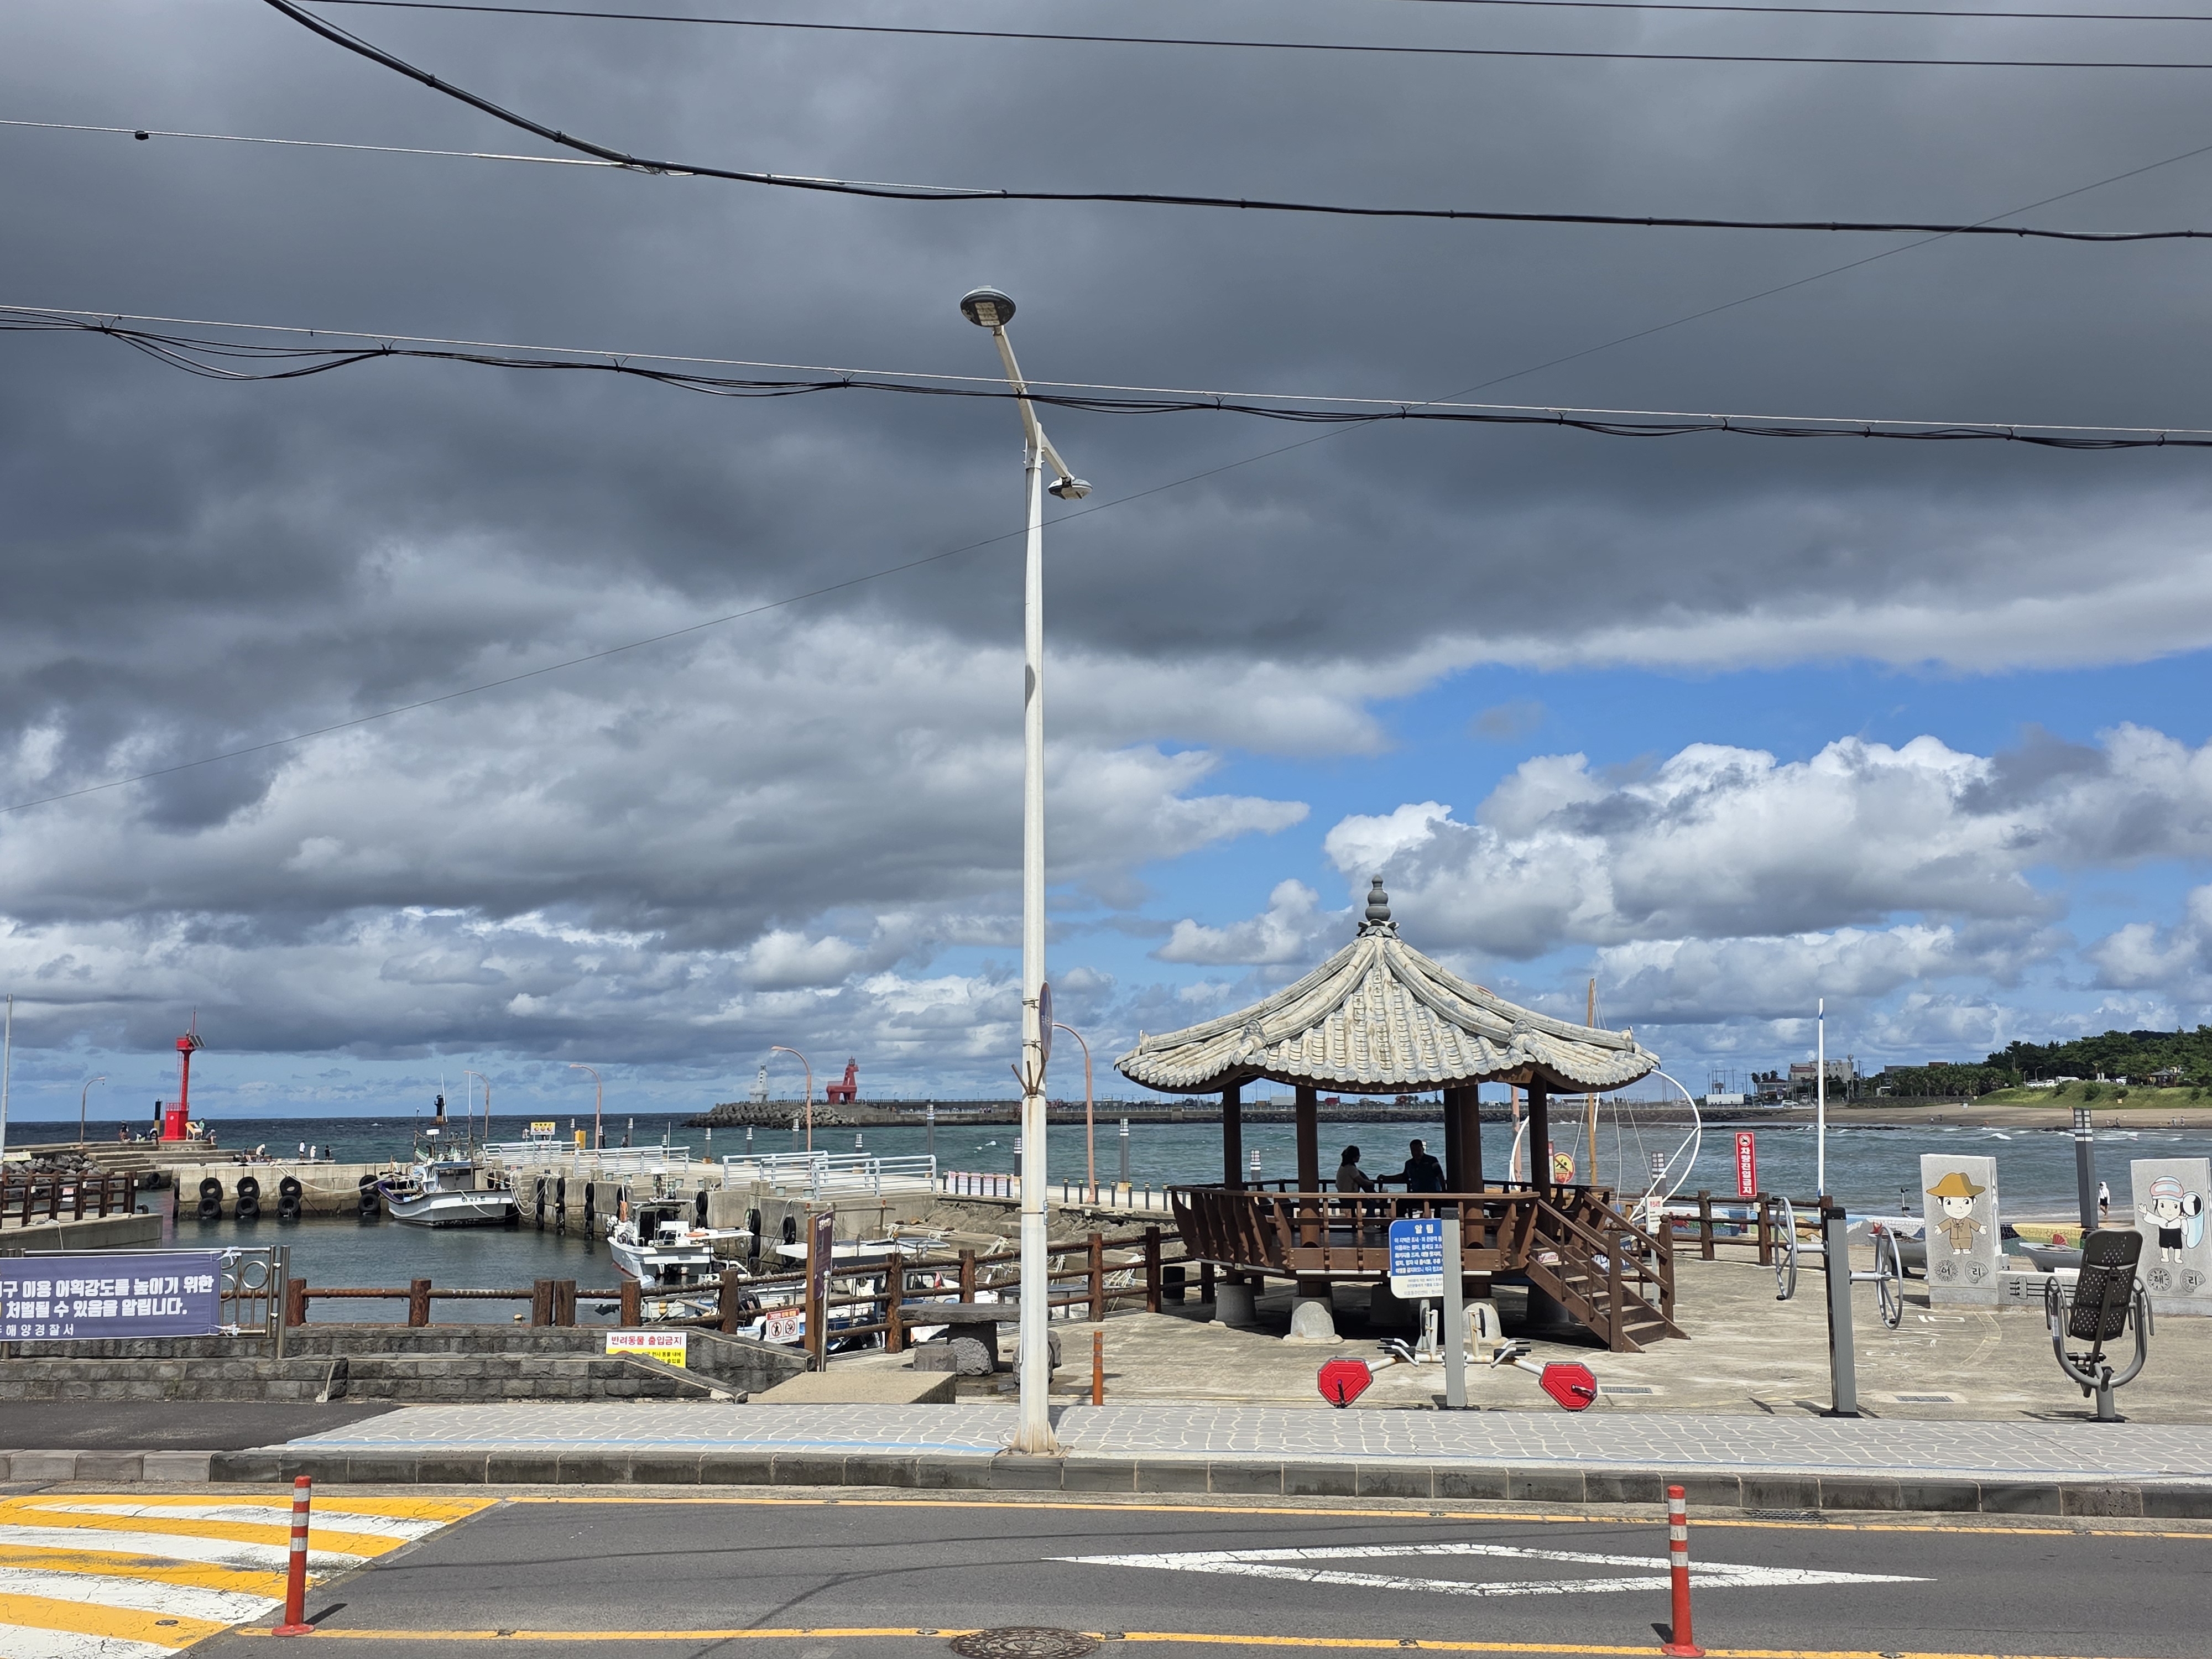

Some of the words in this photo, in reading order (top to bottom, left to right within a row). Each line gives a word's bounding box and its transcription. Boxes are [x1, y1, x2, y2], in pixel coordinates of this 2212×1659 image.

[1740, 1147, 1752, 1194] 차량진입금지
[0, 1281, 18, 1298] 구
[23, 1280, 52, 1298] 이용
[56, 1279, 129, 1297] 어획강도를
[134, 1277, 179, 1295] 높이기
[184, 1275, 214, 1293] 위한
[6, 1301, 50, 1318] 처벌될
[54, 1301, 69, 1318] 수
[73, 1300, 118, 1318] 있음을
[122, 1297, 187, 1316] 알립니다.
[0, 1323, 74, 1337] 해양경찰서
[611, 1336, 645, 1345] 반려동물
[648, 1335, 682, 1345] 출입금지
